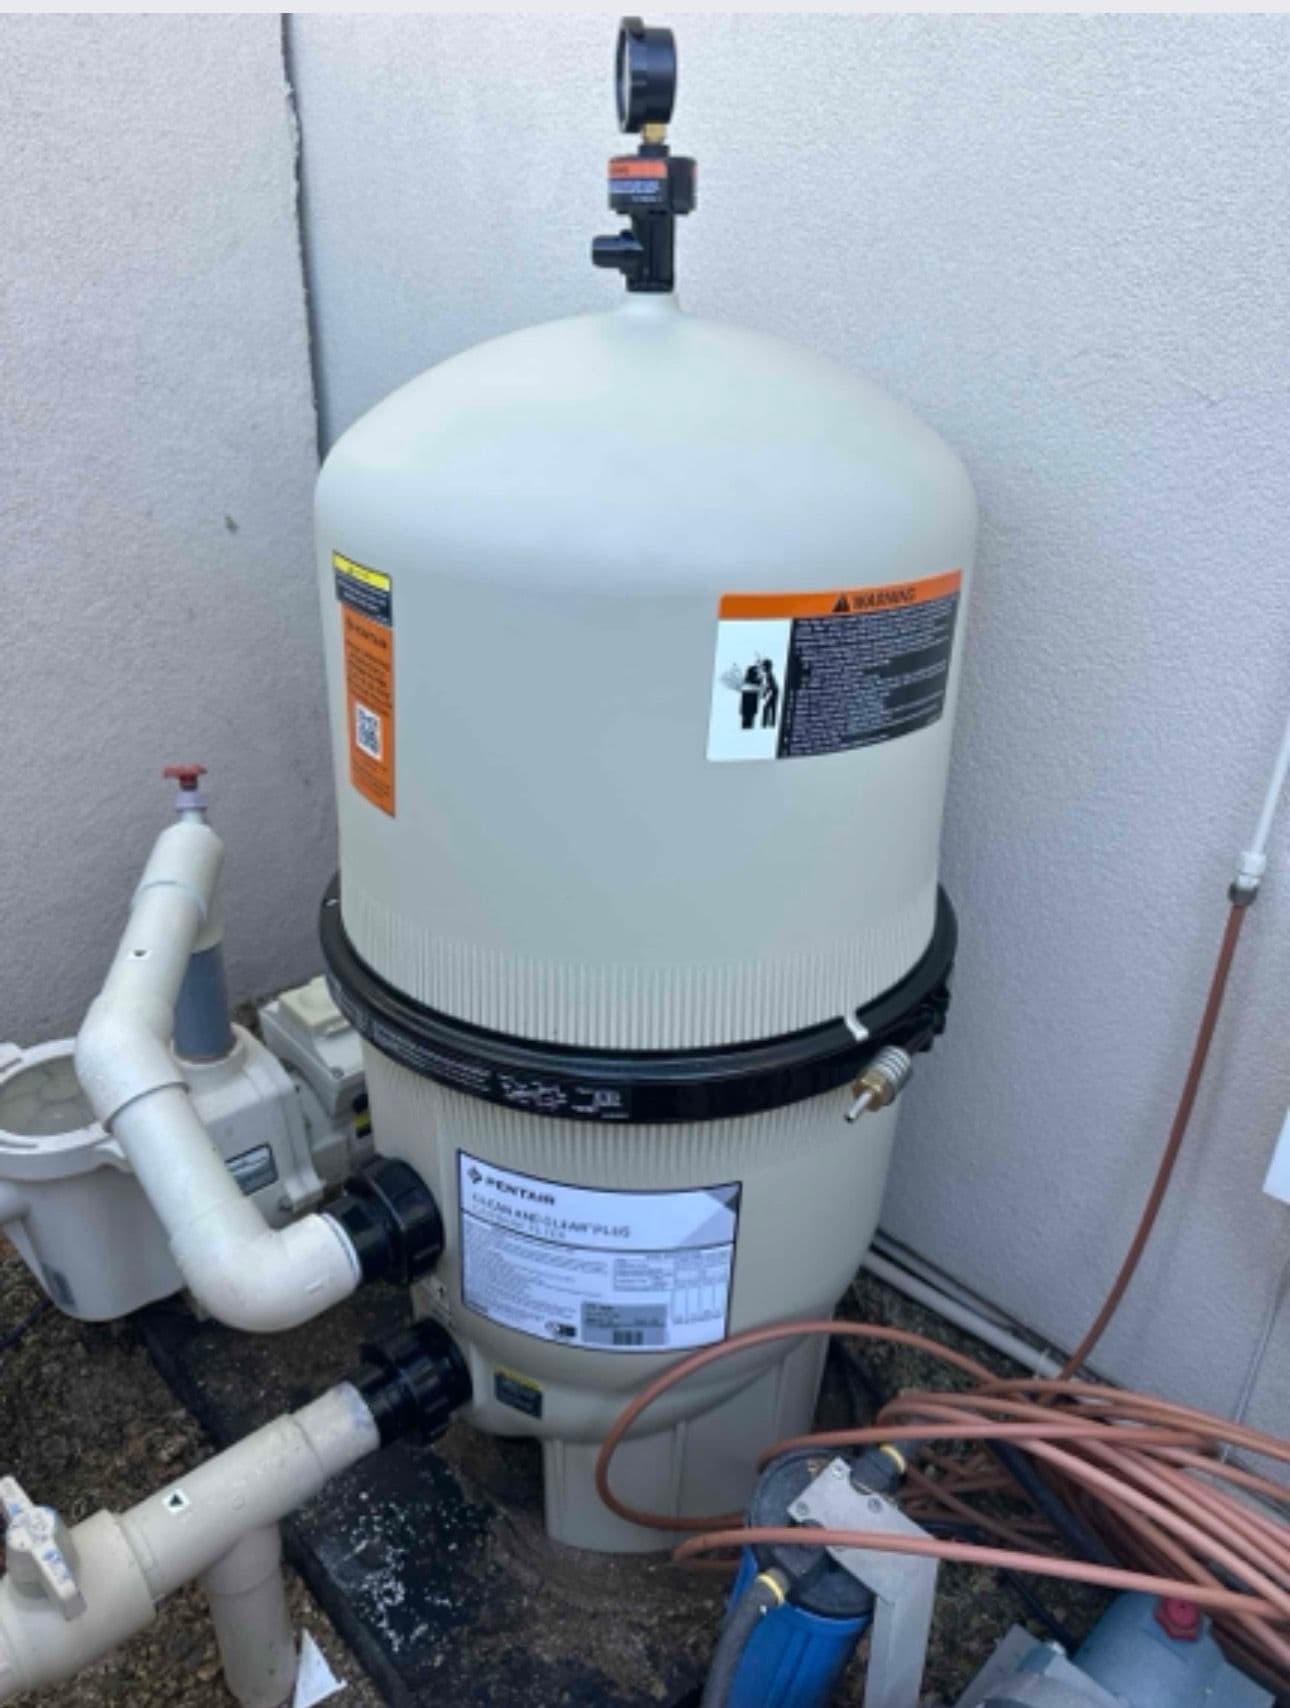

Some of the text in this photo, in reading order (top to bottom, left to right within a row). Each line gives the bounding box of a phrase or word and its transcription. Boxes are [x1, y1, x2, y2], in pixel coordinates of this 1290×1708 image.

[852, 586, 916, 609] WARNING
[485, 1176, 555, 1206] PENTAIR
[592, 1222, 631, 1240] PLUS
